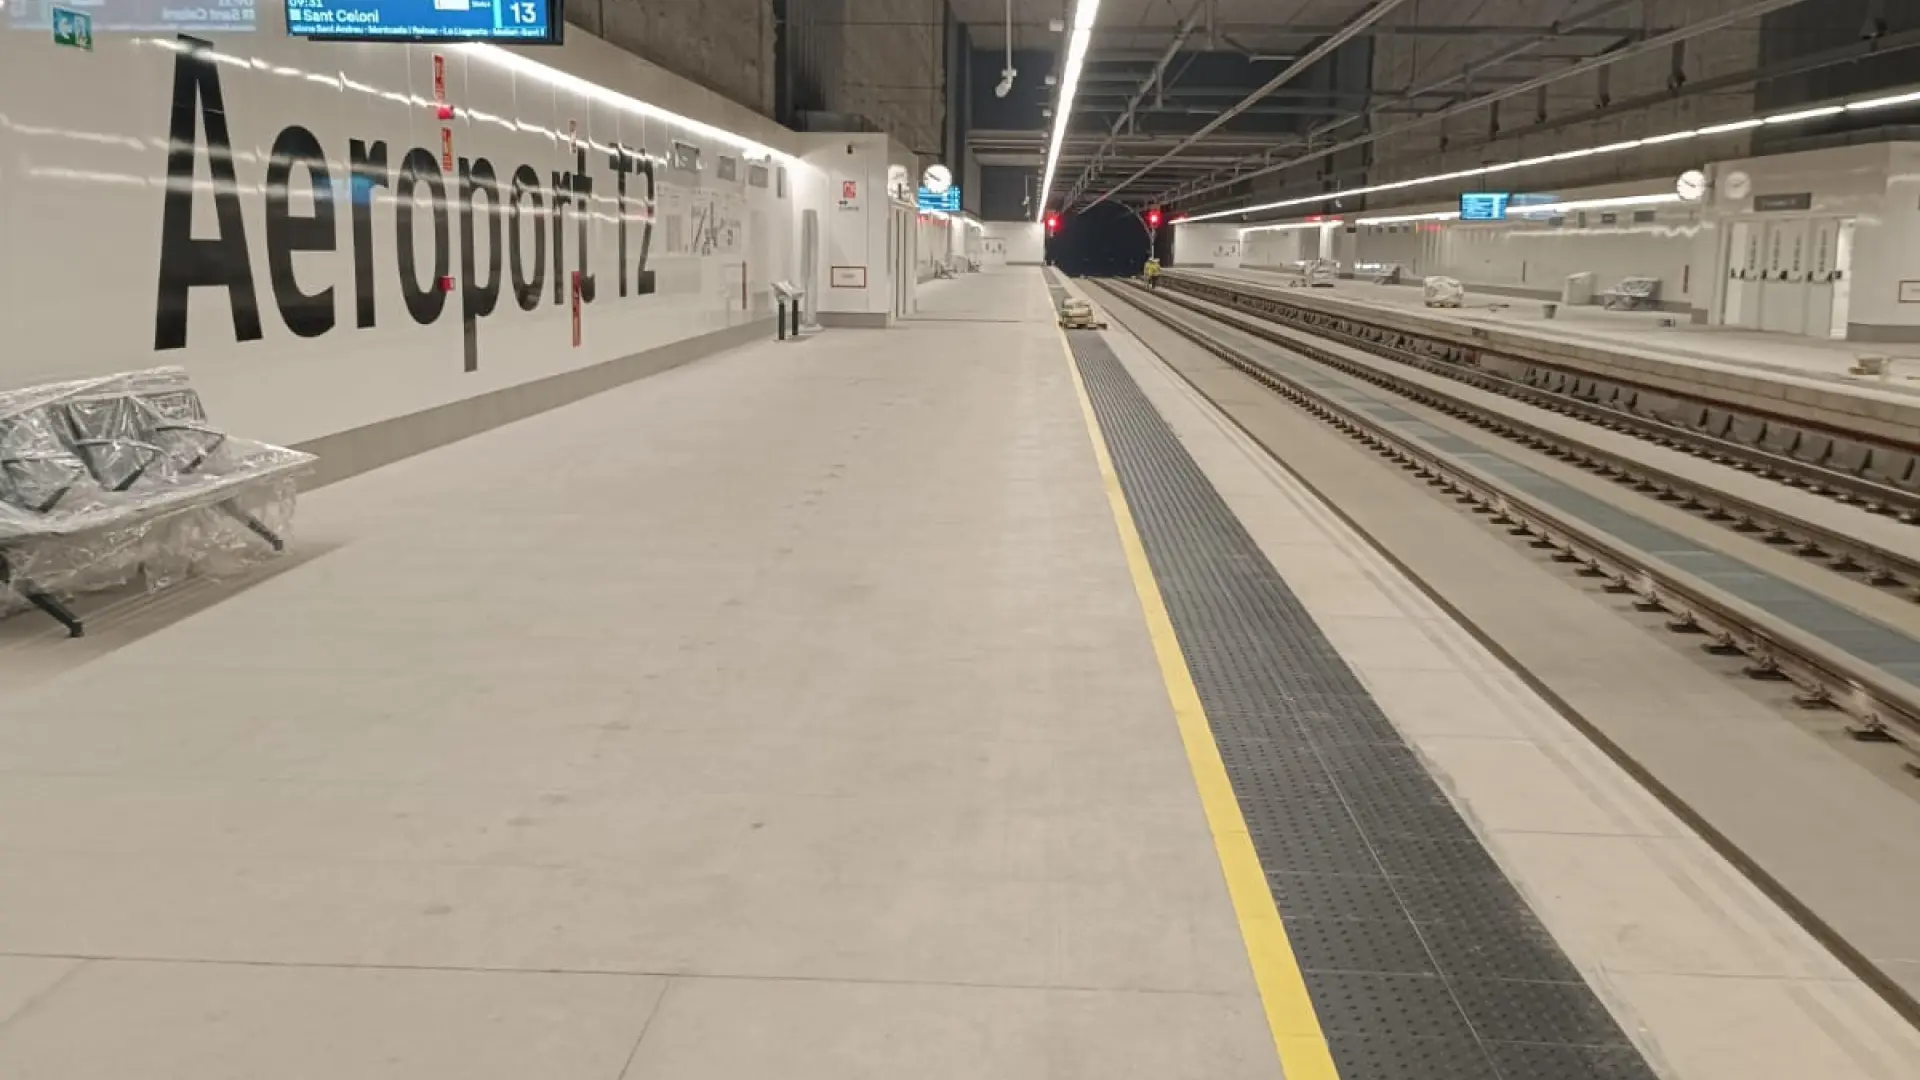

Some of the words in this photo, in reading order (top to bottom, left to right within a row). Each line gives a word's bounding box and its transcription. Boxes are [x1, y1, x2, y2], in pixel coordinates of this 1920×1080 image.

[303, 9, 334, 22] Sant
[336, 8, 380, 23] Celoni
[510, 2, 537, 24] 13
[154, 33, 596, 373] Aeroport
[608, 142, 656, 297] T2
